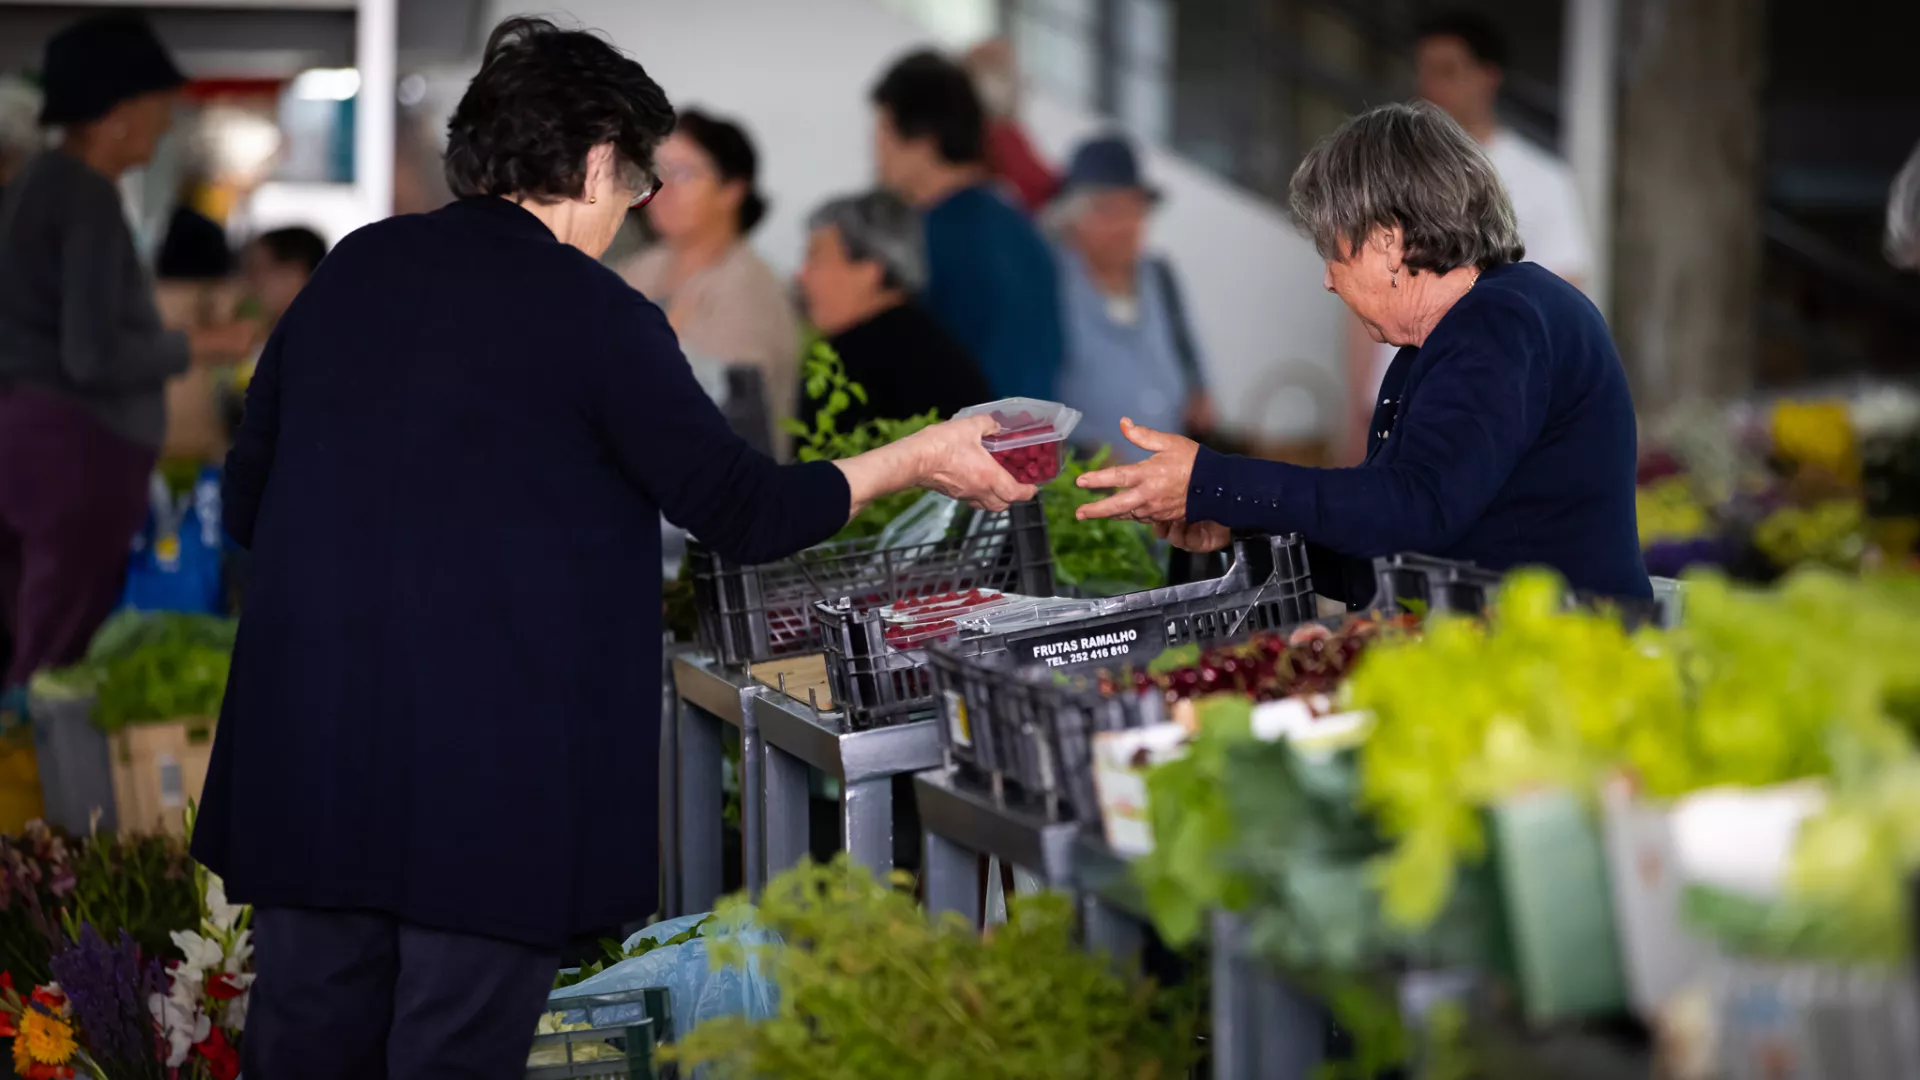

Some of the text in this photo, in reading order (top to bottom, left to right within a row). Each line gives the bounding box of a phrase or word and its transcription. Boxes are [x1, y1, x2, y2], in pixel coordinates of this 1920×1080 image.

[1033, 629, 1137, 658] FRUTAS RAMALHO
[1045, 644, 1129, 667] TEL. 252 416 810
